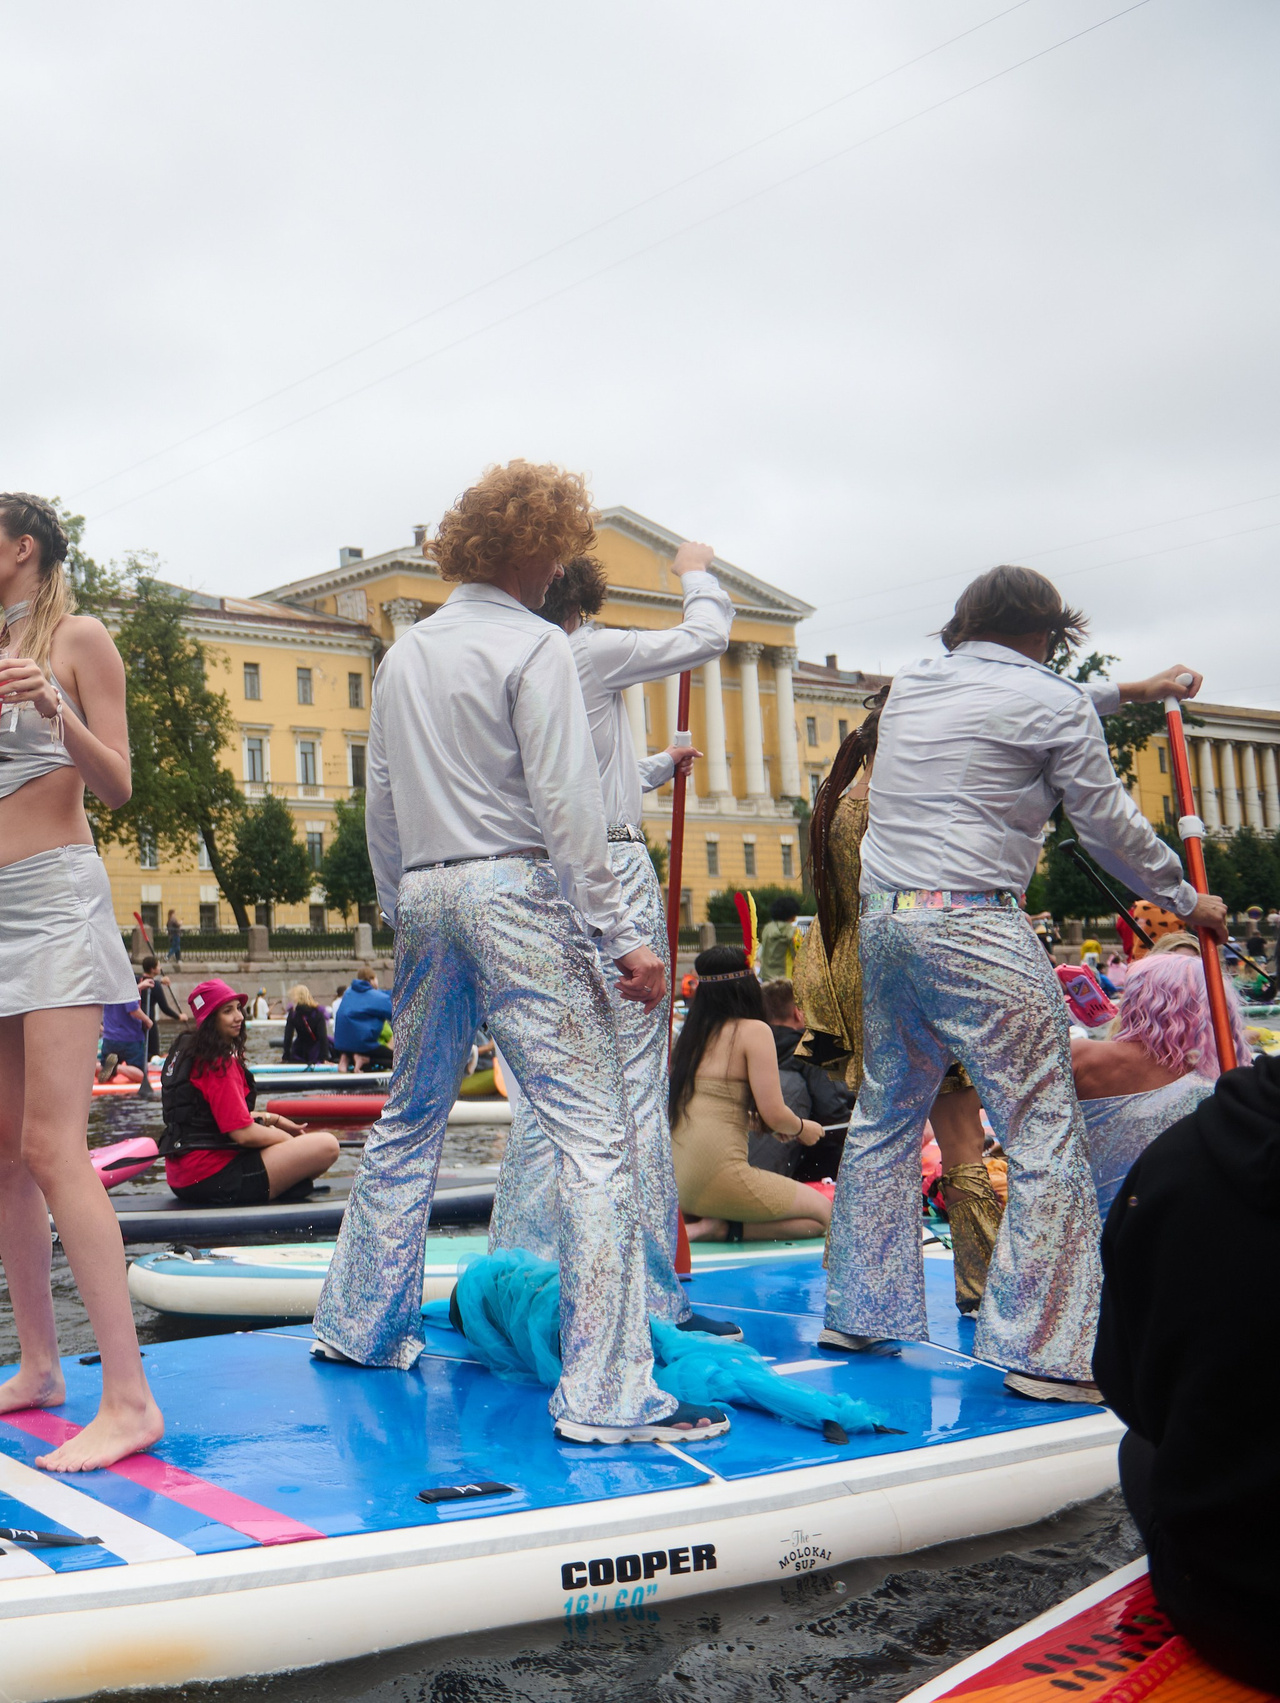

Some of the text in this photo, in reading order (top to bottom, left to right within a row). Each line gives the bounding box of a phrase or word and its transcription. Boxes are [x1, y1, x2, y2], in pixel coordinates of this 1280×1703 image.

[792, 1530, 809, 1547] The
[561, 1543, 718, 1591] COOPER
[778, 1546, 832, 1570] MOLOKAI
[795, 1558, 816, 1571] SUP
